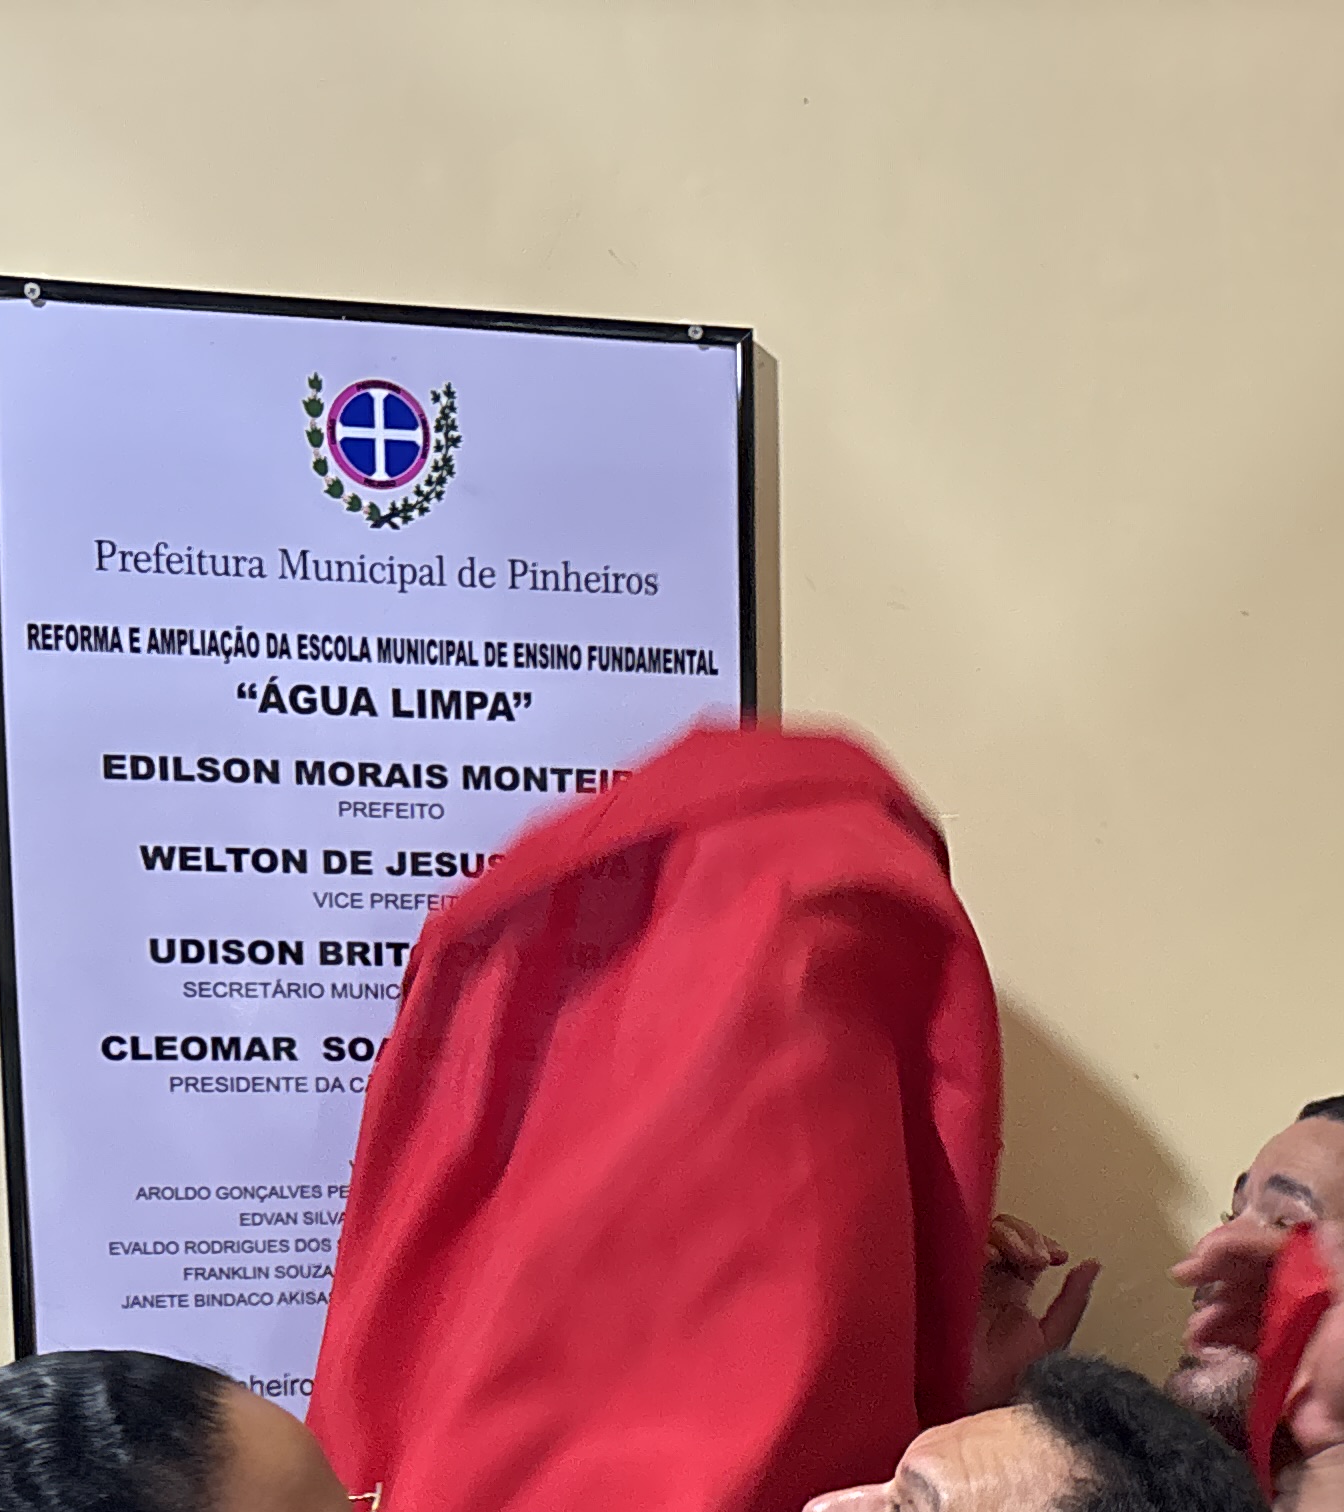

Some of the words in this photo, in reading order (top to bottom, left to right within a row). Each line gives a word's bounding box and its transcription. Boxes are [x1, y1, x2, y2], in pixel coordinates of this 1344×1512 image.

[94, 539, 267, 579] Prefeitura
[278, 548, 447, 594] Municipal
[457, 556, 496, 589] de
[508, 558, 659, 596] Pinheiros
[26, 623, 124, 653] REFORMA
[128, 626, 142, 654] E
[146, 625, 260, 665] AMPLIAÇÃO
[266, 632, 292, 660] DA
[296, 633, 372, 663] ESCOLA
[376, 636, 479, 667] MUNICIPAL
[484, 641, 508, 668] DE
[513, 642, 582, 671] ENSINO
[587, 645, 719, 676] FUNDAMENTAL
[236, 675, 379, 718] “ÁGUA
[391, 687, 532, 722] LIMPA”
[102, 753, 281, 785] EDILSON
[294, 760, 449, 790] MORAIS
[338, 800, 445, 820] PREFEITO
[139, 844, 308, 874] WELTON
[322, 849, 374, 876] DE
[312, 891, 364, 910] VICE
[149, 938, 304, 966] UDISON
[319, 940, 418, 968] BRIT
[182, 978, 325, 999] SECRETÁRIO
[101, 1035, 299, 1062] CLEOMAR
[169, 1076, 309, 1093] PRESIDENTE
[315, 1076, 346, 1093] DA
[135, 1185, 212, 1201] AROLDO
[215, 1184, 323, 1204] GONÇALVES
[239, 1211, 298, 1227] EDVAN
[108, 1240, 180, 1256] EVALDO
[184, 1238, 291, 1255] RODRIGUES
[294, 1237, 332, 1253] DOS
[183, 1266, 270, 1281] FRANKLIN
[274, 1263, 333, 1280] SOUZA
[121, 1293, 190, 1310] JANETE
[193, 1291, 274, 1308] BINDACO
[277, 1291, 332, 1306] AKISA
